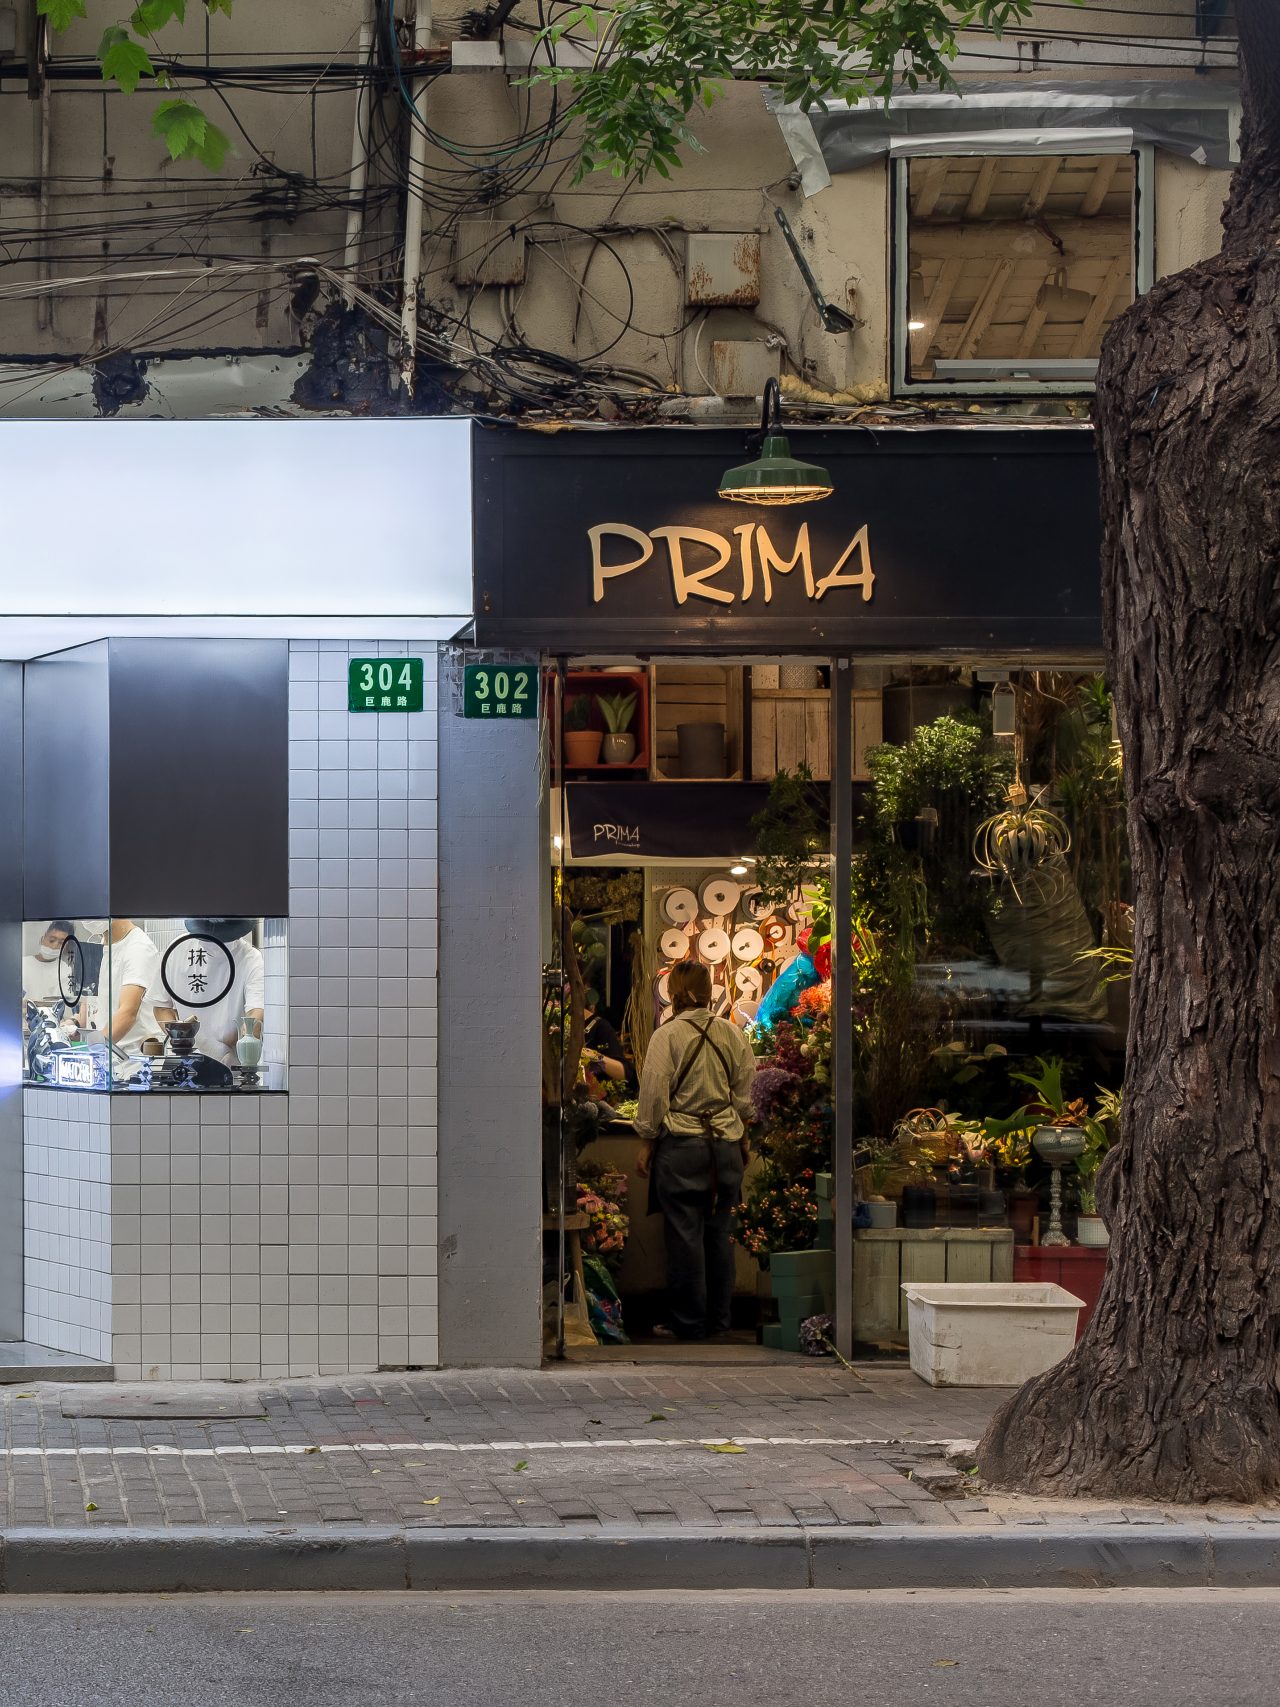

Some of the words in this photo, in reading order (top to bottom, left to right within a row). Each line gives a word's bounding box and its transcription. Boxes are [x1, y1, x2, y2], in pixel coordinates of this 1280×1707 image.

[587, 522, 877, 606] PRIMA
[359, 663, 412, 691] 304
[474, 671, 528, 700] 302
[365, 696, 408, 707] 巨鹿路
[481, 703, 523, 714] 巨鹿路
[593, 823, 640, 842] PRIMA
[188, 948, 208, 994] 抹茶
